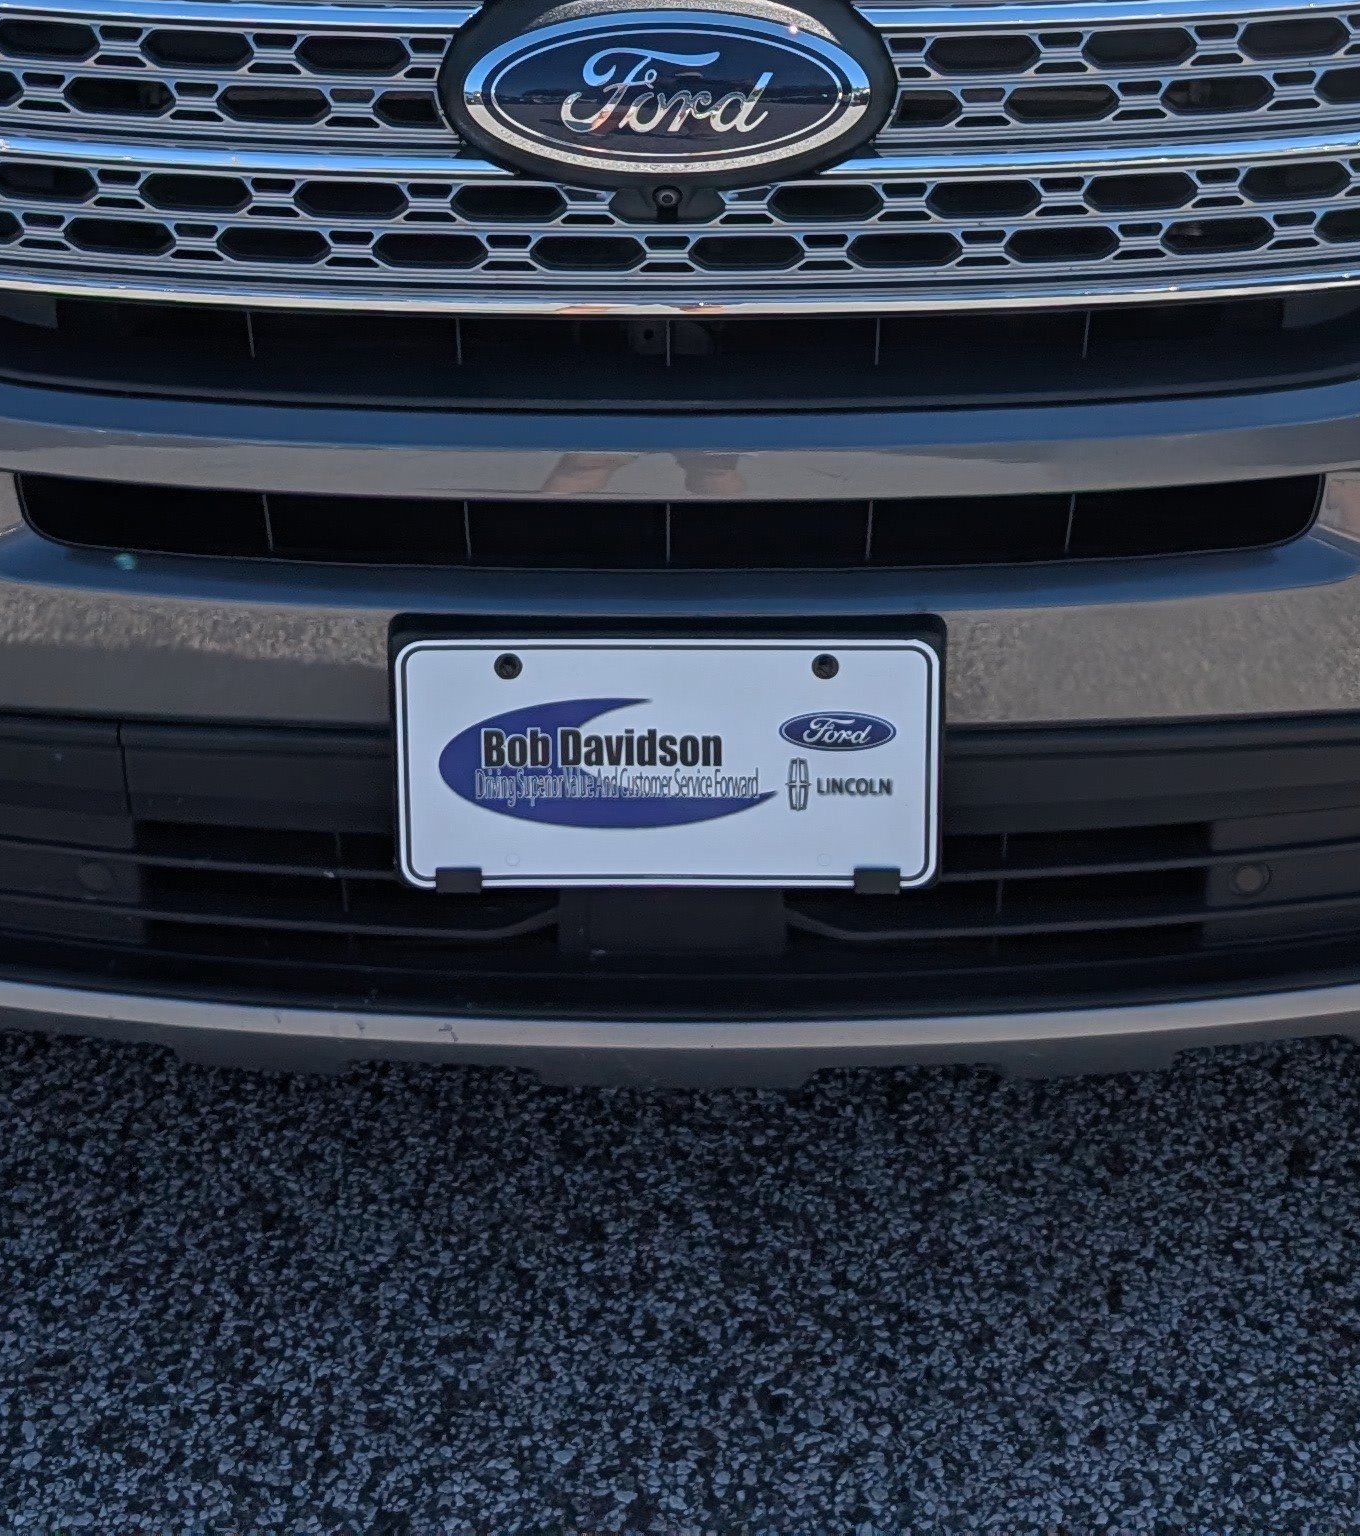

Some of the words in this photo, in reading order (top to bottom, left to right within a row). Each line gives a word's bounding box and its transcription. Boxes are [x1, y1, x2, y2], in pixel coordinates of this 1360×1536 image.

[560, 47, 773, 134] Ford
[482, 728, 551, 767] Bob
[560, 728, 723, 767] Davidson
[802, 717, 873, 744] Ford
[474, 768, 516, 807] Driving
[517, 767, 563, 807] Superior
[563, 766, 595, 798] Value
[594, 766, 619, 798] And
[620, 767, 672, 798] Customer
[674, 767, 713, 797] Service
[714, 766, 759, 798] Forward
[816, 777, 893, 795] LINCOLN
